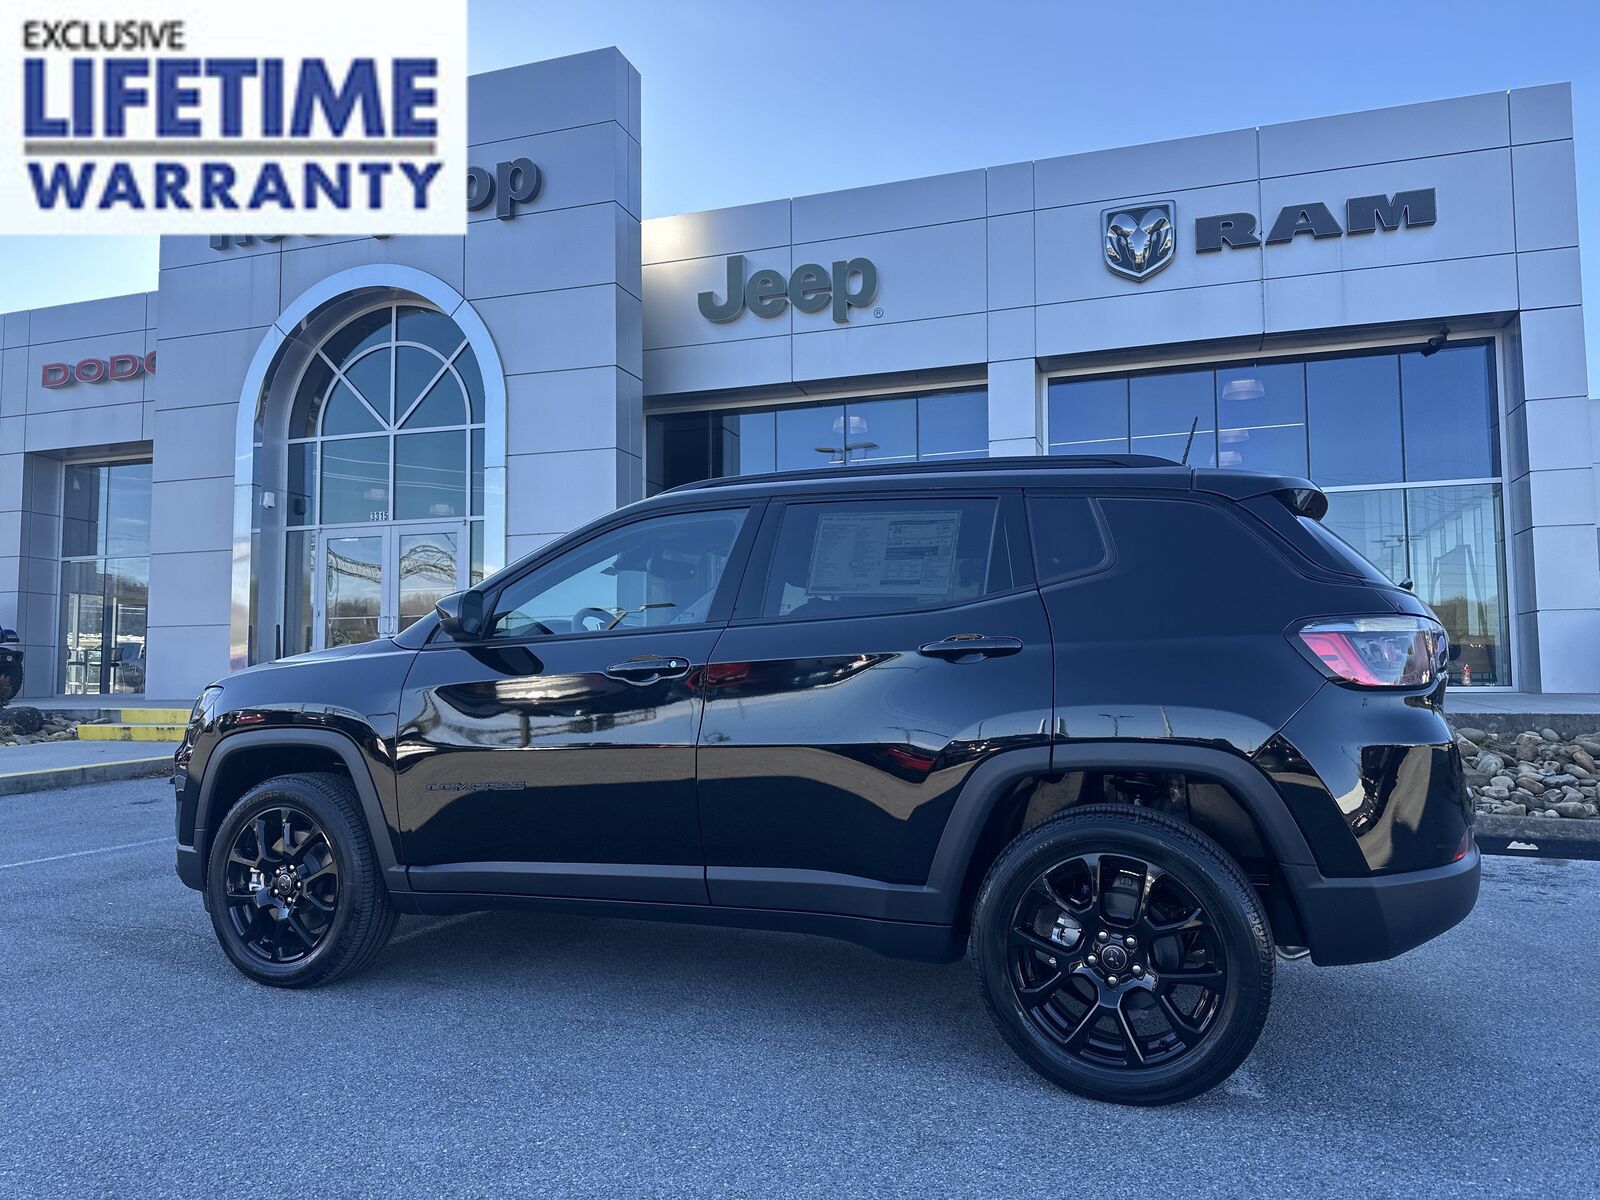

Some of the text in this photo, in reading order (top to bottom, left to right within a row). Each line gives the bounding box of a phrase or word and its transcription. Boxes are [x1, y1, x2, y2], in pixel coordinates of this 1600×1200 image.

[1195, 187, 1437, 254] RAM
[697, 254, 879, 324] Jeep
[371, 511, 388, 521] 3315
